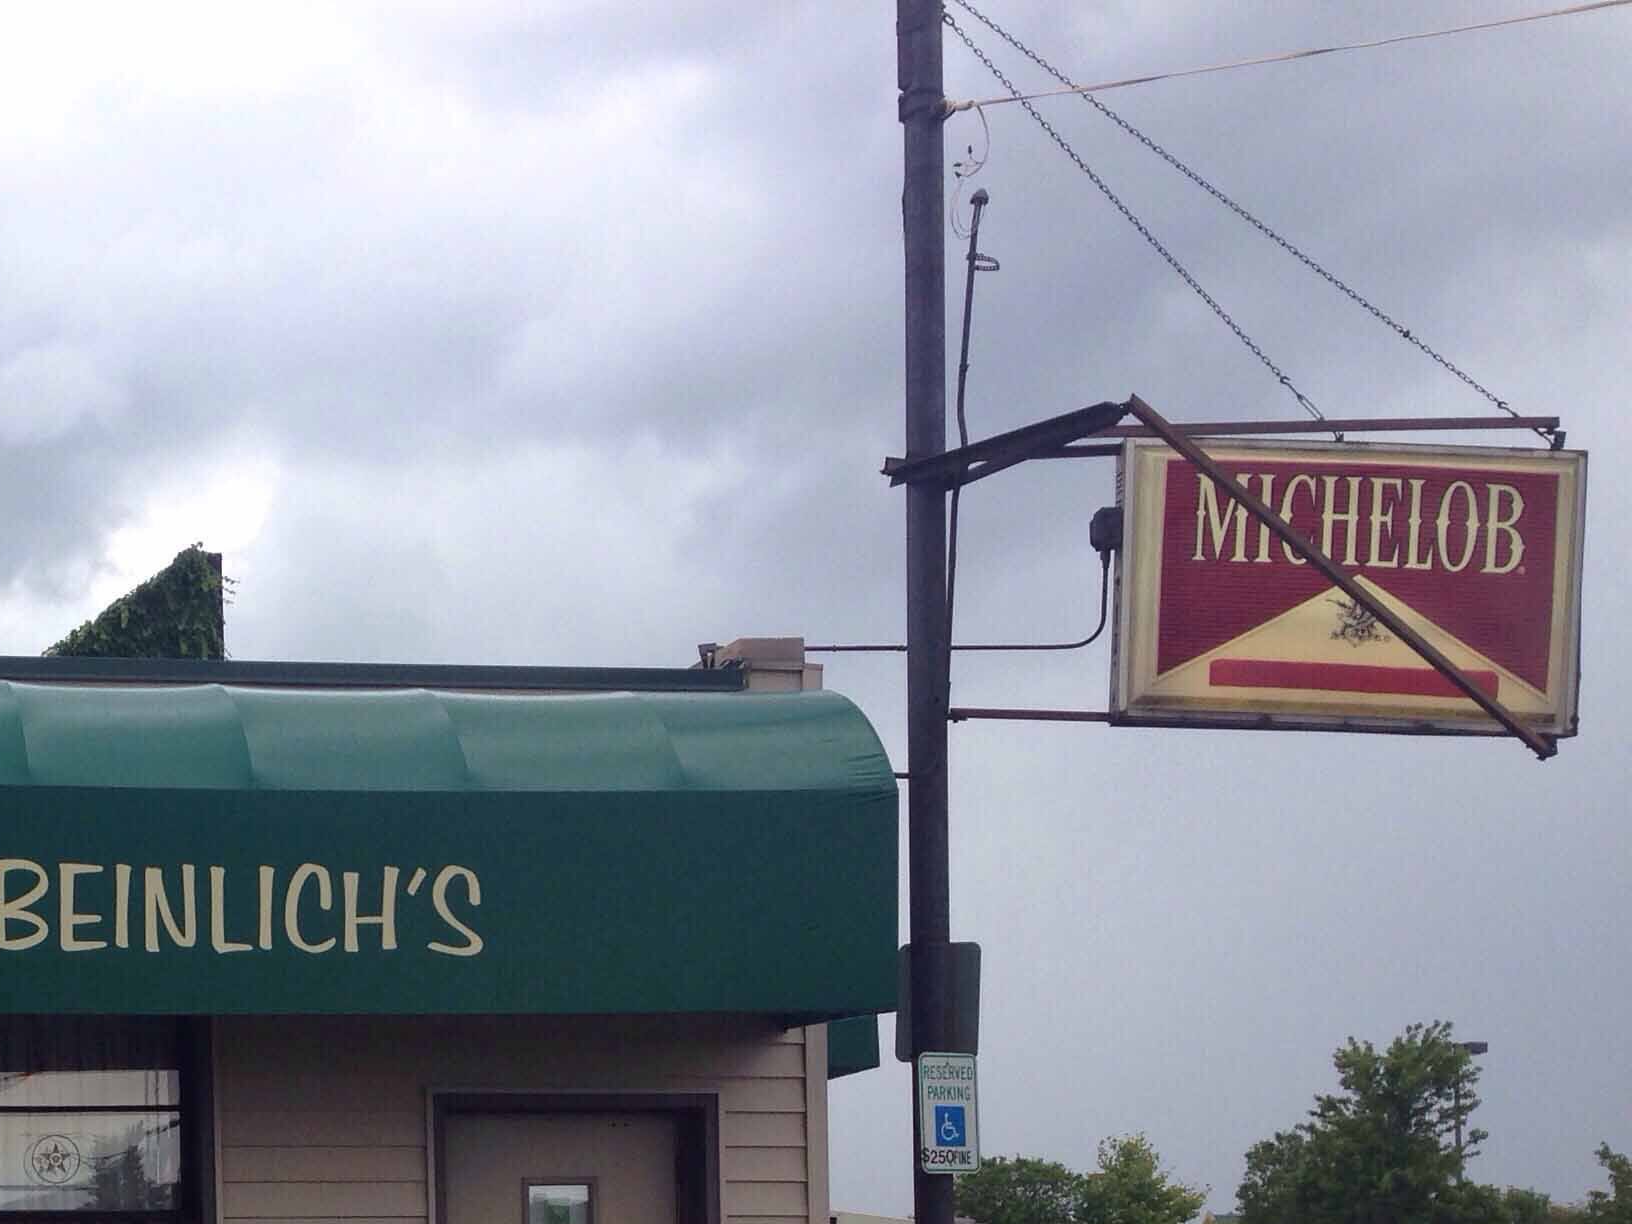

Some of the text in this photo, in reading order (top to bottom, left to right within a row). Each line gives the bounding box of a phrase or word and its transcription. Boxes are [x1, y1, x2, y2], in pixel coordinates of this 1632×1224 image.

[1192, 472, 1526, 575] MICHELOB
[923, 1064, 973, 1080] RESERVED
[928, 1085, 971, 1101] PARKING
